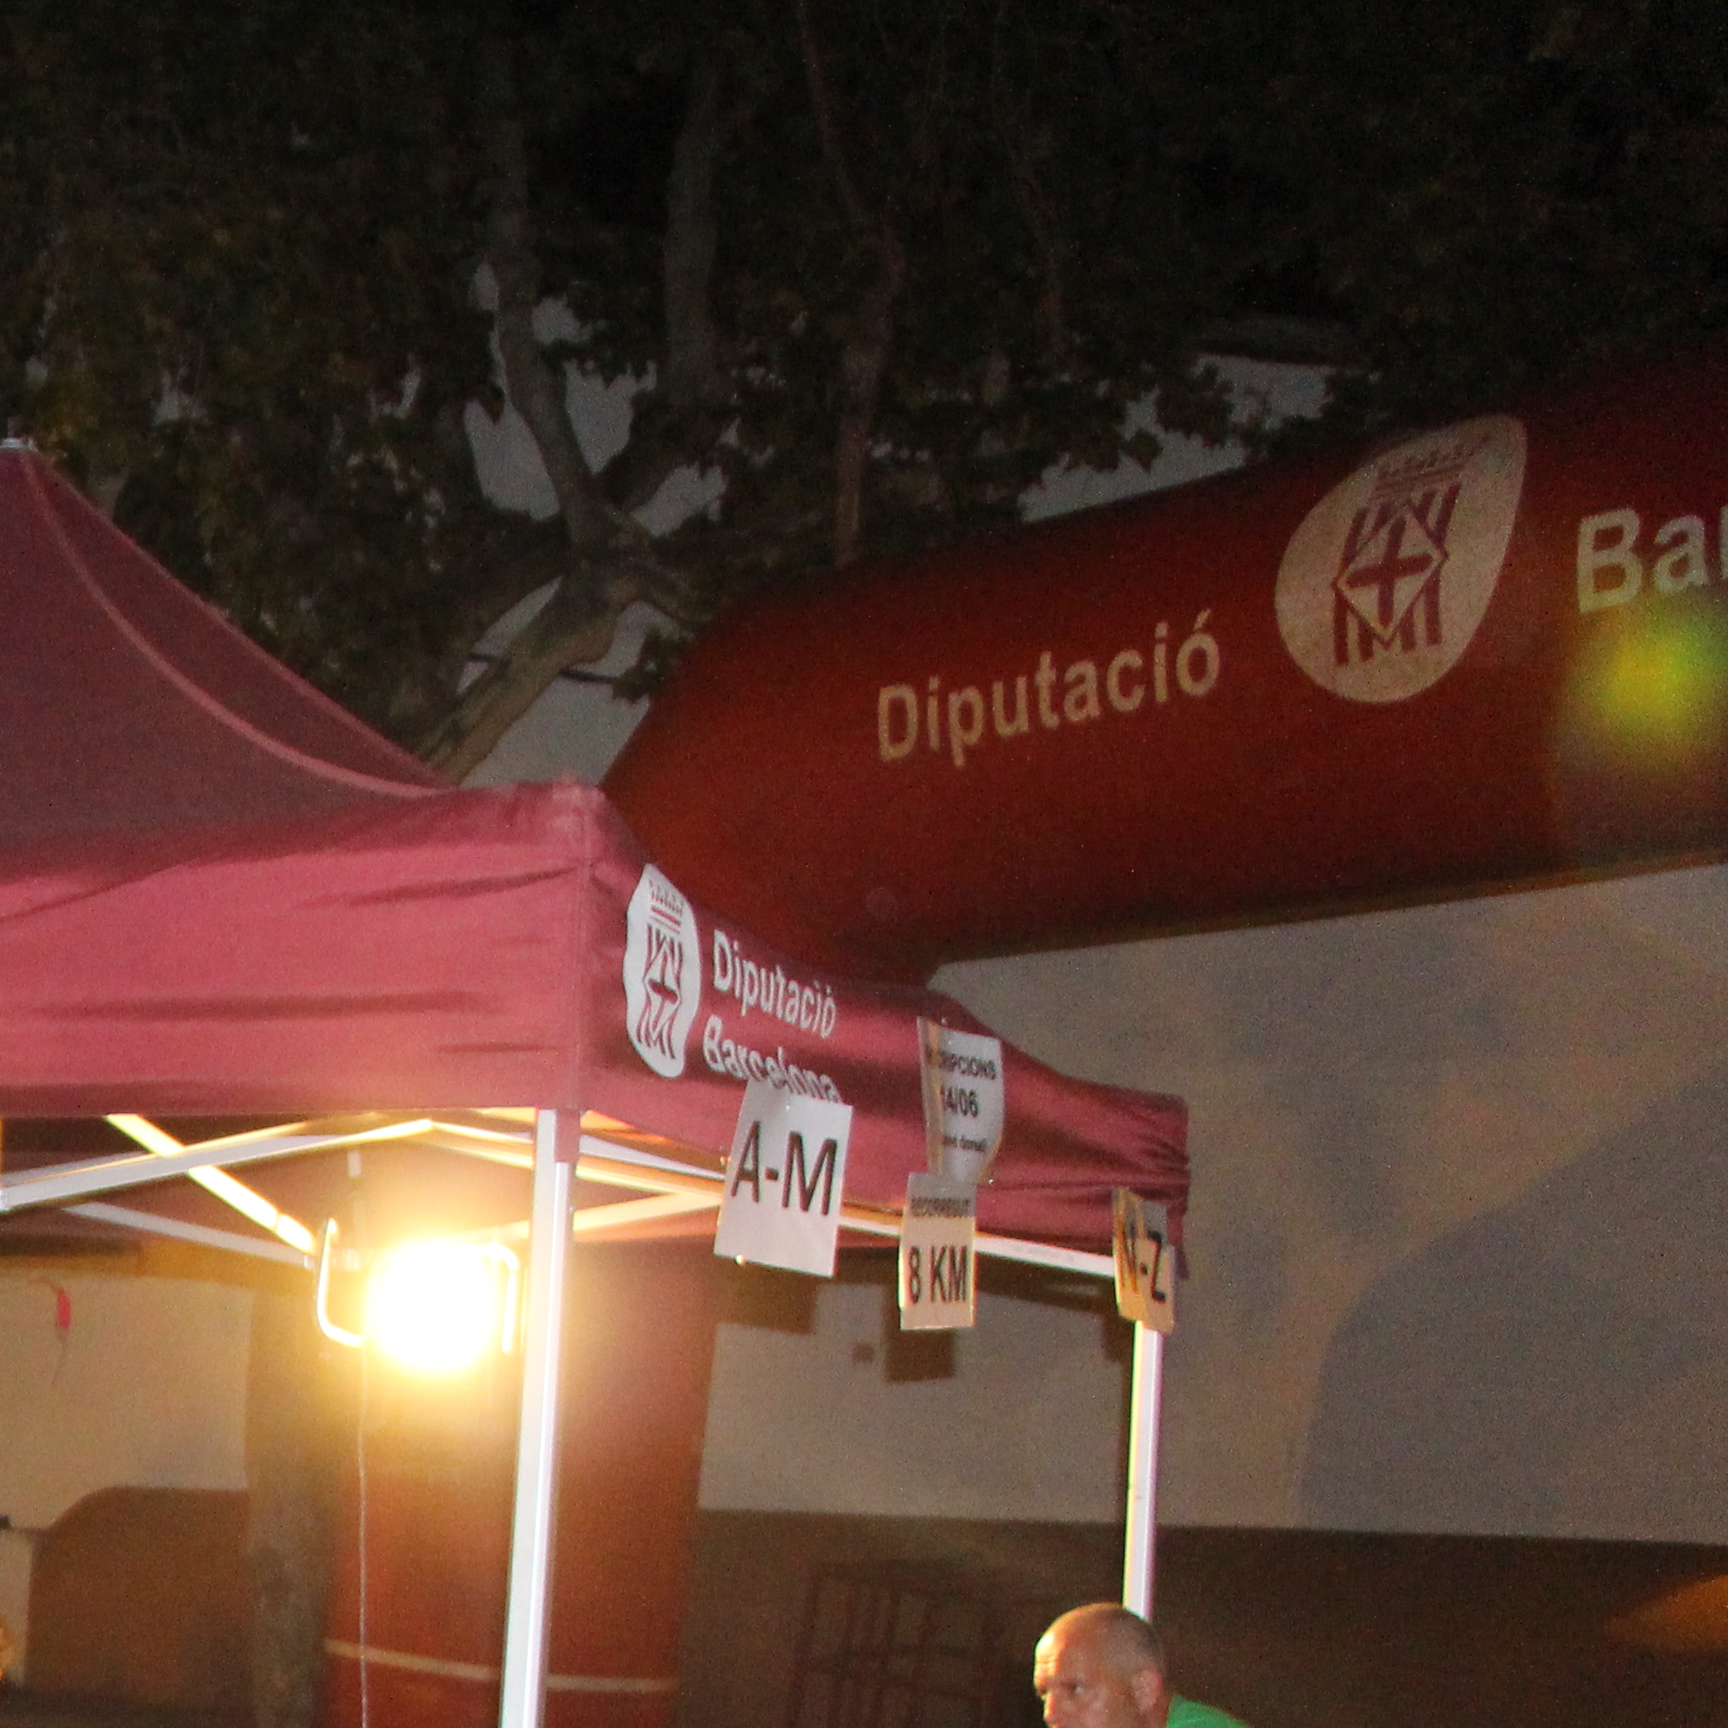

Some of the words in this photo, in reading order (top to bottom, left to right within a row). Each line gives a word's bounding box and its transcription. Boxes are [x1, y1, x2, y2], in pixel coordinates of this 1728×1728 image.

[878, 608, 1221, 768] Diputació
[1577, 507, 1728, 614] Ba
[712, 929, 837, 1039] Diputació
[702, 1014, 843, 1103] Barcelona
[730, 1120, 838, 1216] A-M
[909, 1245, 922, 1305] 8
[930, 1244, 967, 1304] KM
